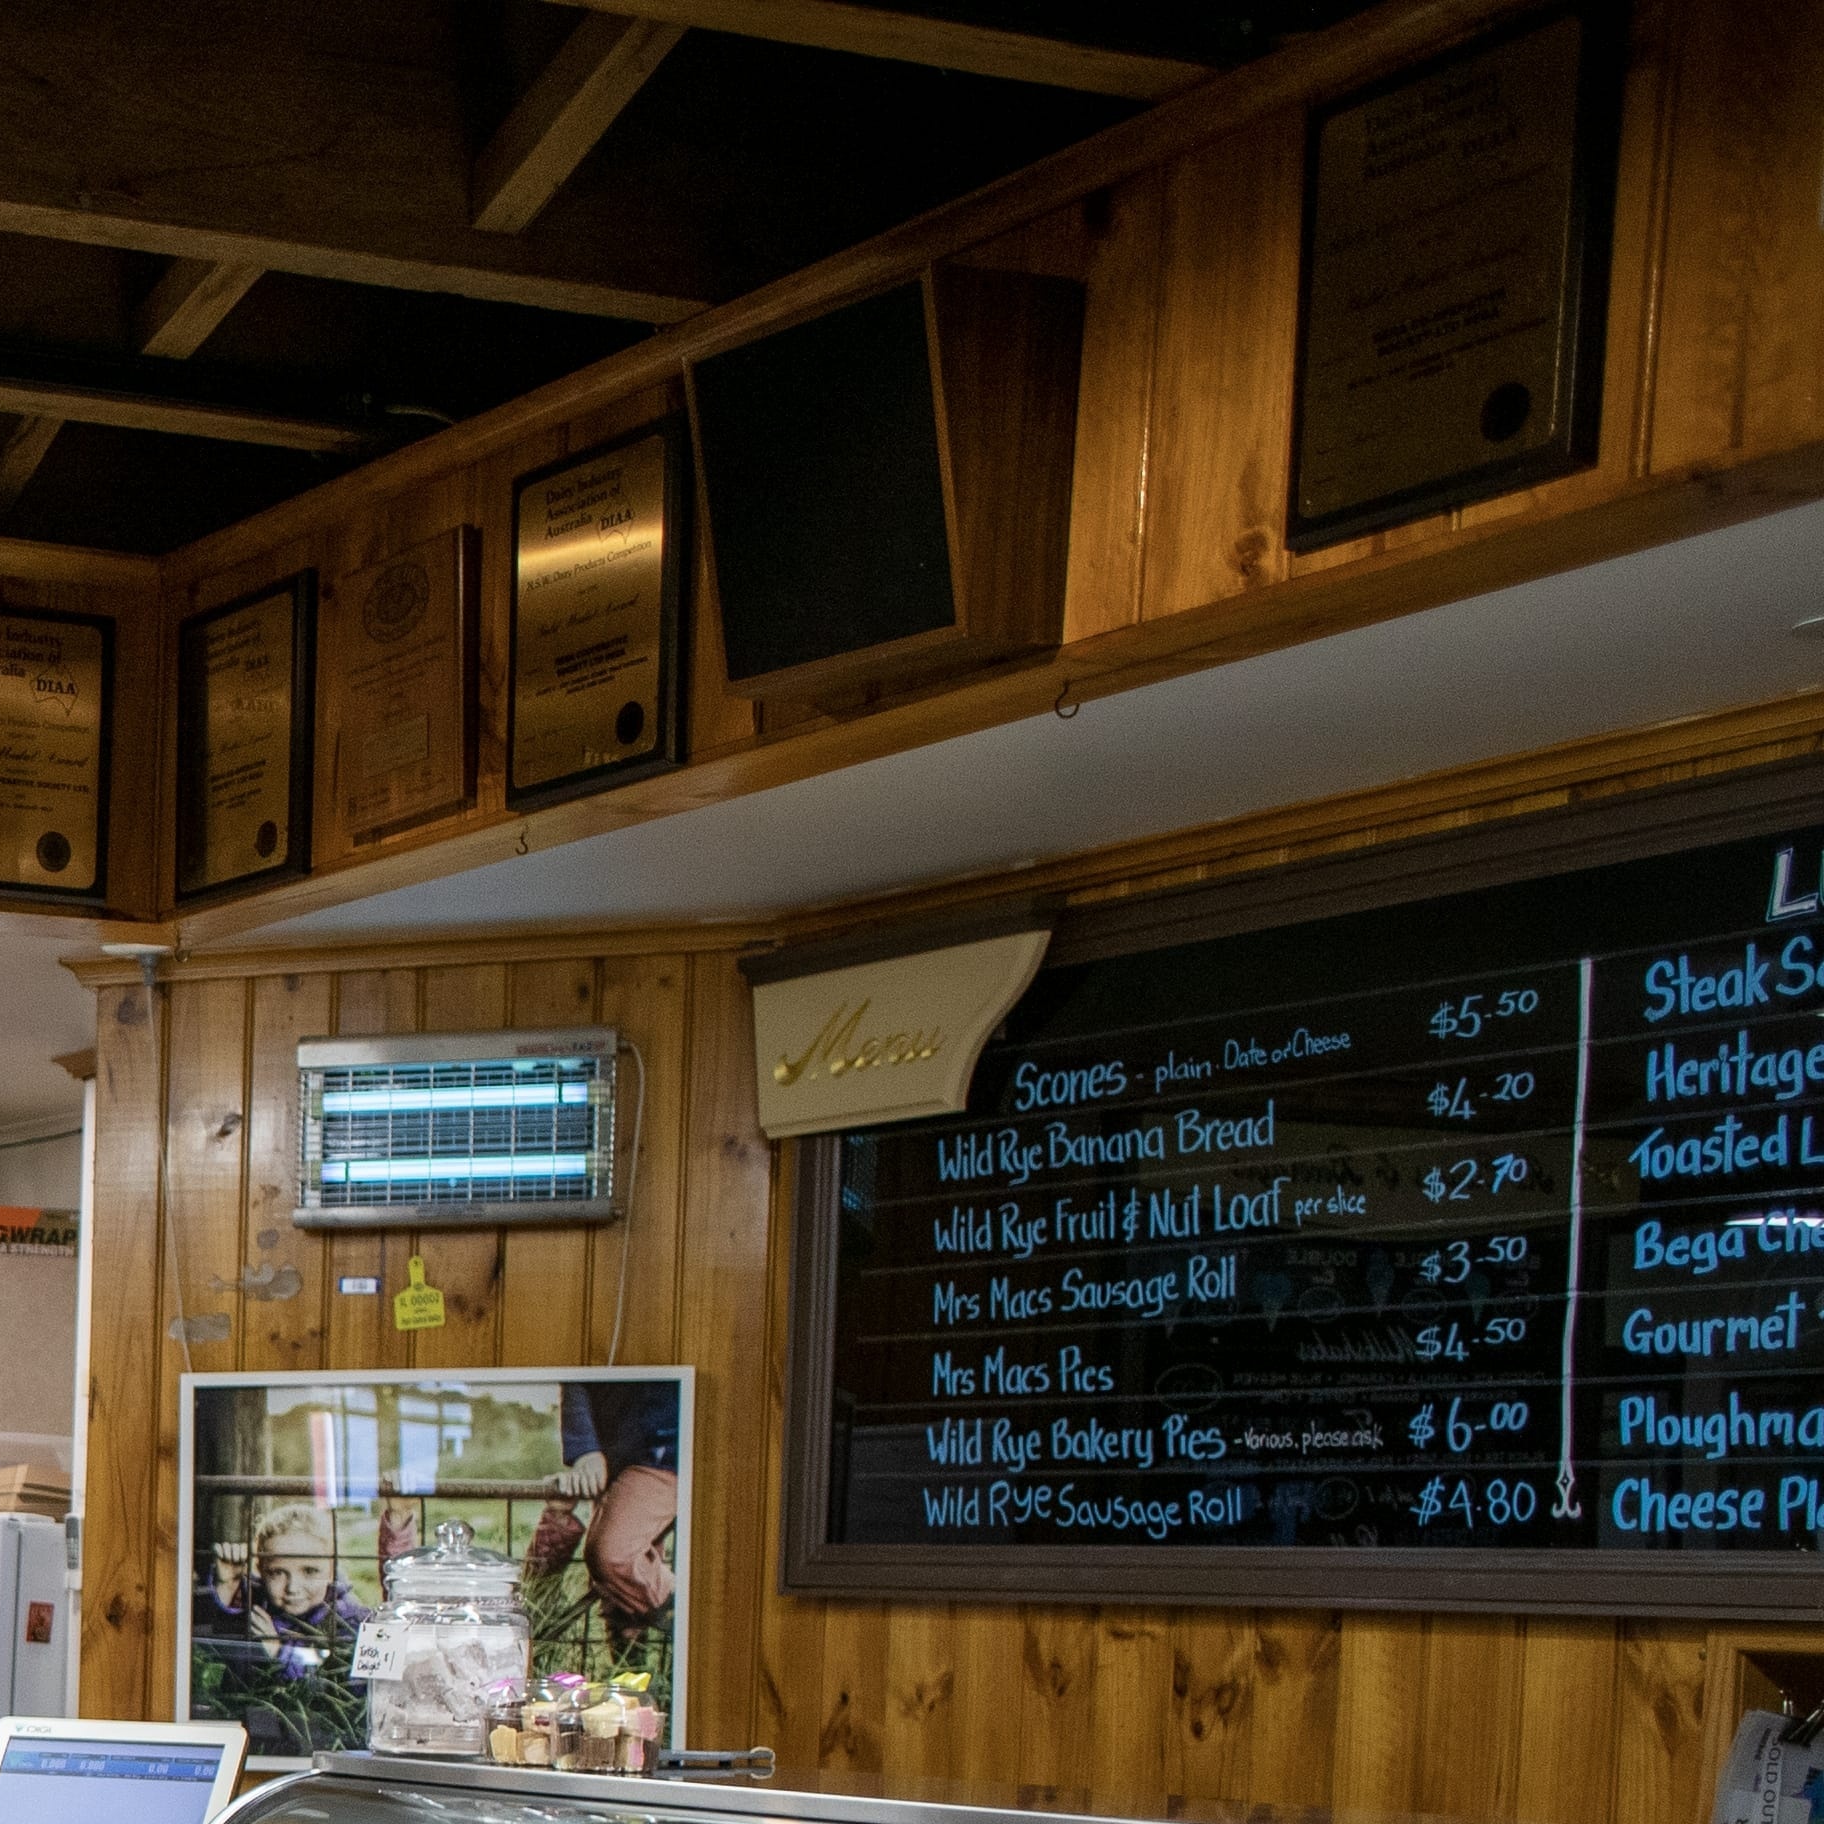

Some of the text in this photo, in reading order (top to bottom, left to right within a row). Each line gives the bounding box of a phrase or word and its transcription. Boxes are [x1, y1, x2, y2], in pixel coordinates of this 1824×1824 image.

[1643, 942, 1770, 1023] Steak
[772, 997, 944, 1087] Menu
[1647, 1029, 1824, 1101] Heritage
[1015, 1059, 1128, 1112] Scones
[938, 1099, 1276, 1187] Wild Rye Banana Bread
[1628, 1113, 1790, 1179] Toasted
[934, 1176, 1292, 1260] Wild Rye Fruit & Nut Loaf
[1633, 1220, 1747, 1275] Bega
[933, 1253, 1238, 1326] Mrs Macs Sausage Roll
[1622, 1290, 1807, 1357] Gourmet
[932, 1344, 1116, 1397] Mrs Macs Pies
[925, 1413, 1228, 1474] Wild Rye Bakery Pies
[1618, 1391, 1824, 1460] Ploughma
[923, 1479, 1242, 1540] Wild Rye Sausage Roll
[1612, 1476, 1766, 1533] Cheese
